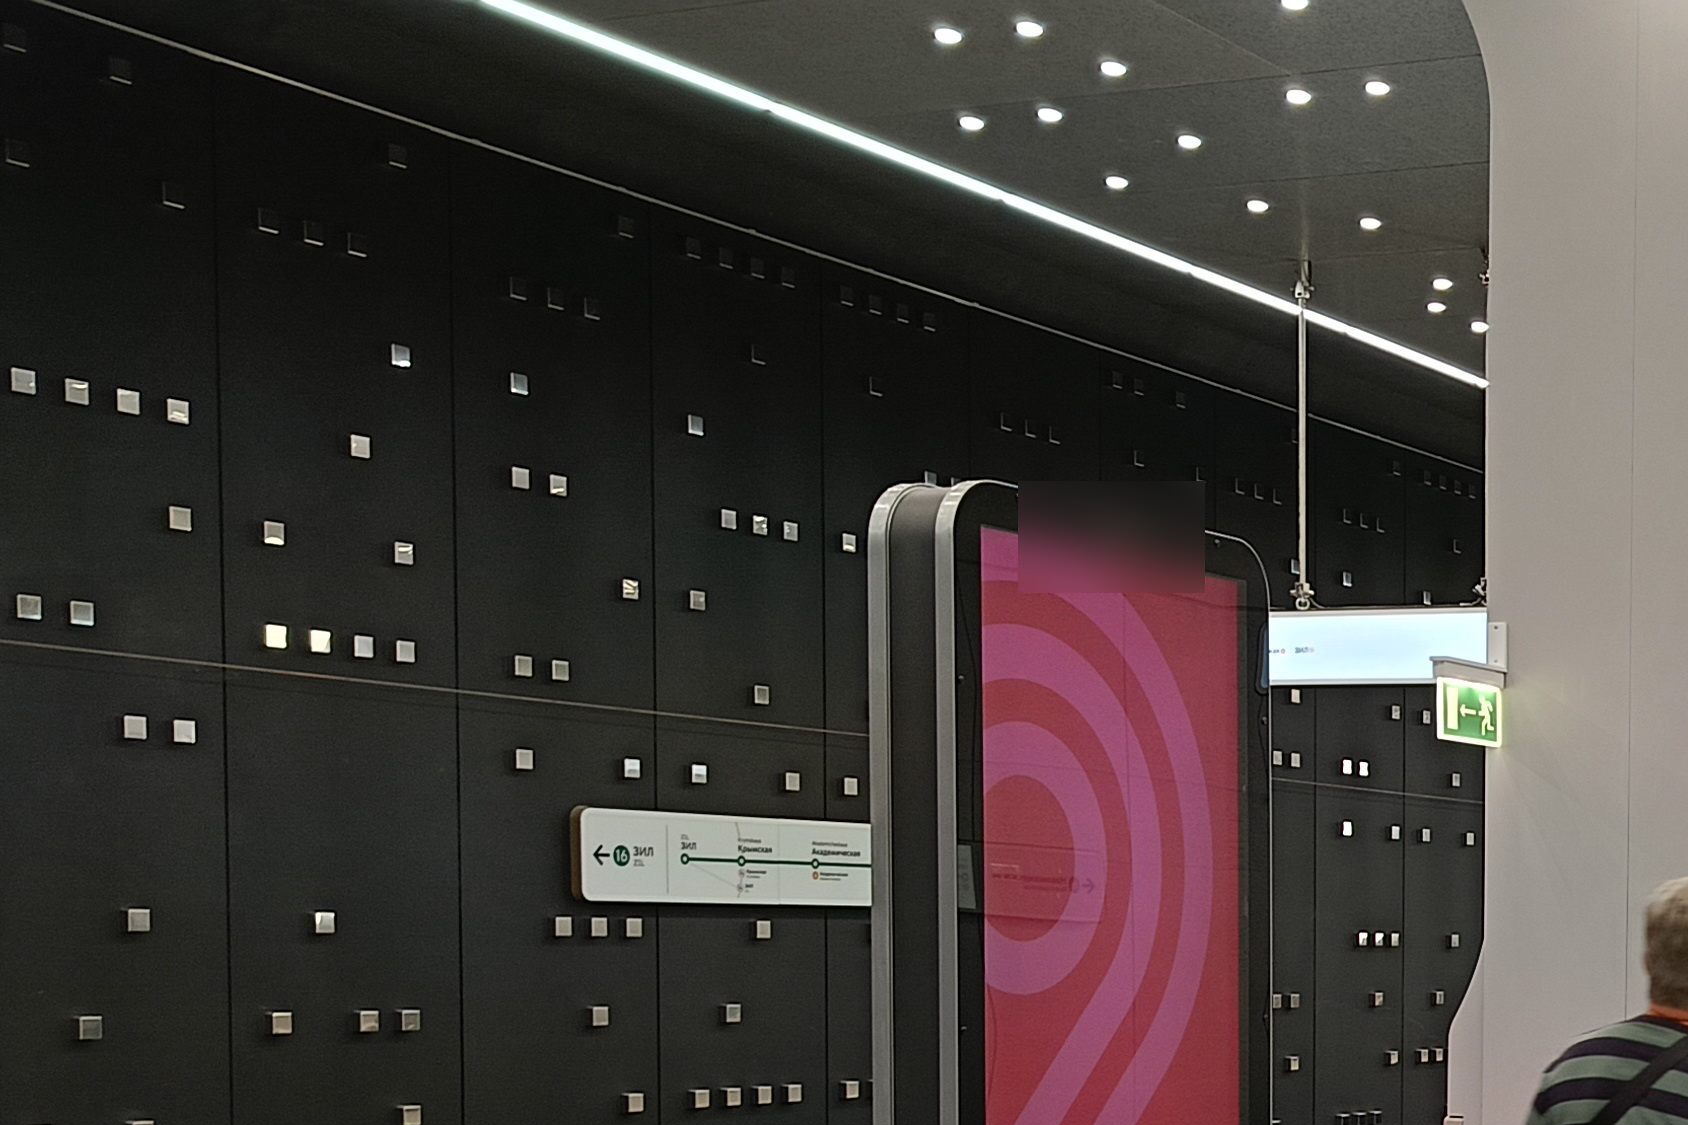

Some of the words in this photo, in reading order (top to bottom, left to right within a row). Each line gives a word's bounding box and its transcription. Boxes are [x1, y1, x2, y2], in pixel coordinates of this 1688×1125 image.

[681, 842, 696, 850] ЗИЛ
[615, 849, 628, 863] 16
[633, 846, 654, 858] ЗИЛ
